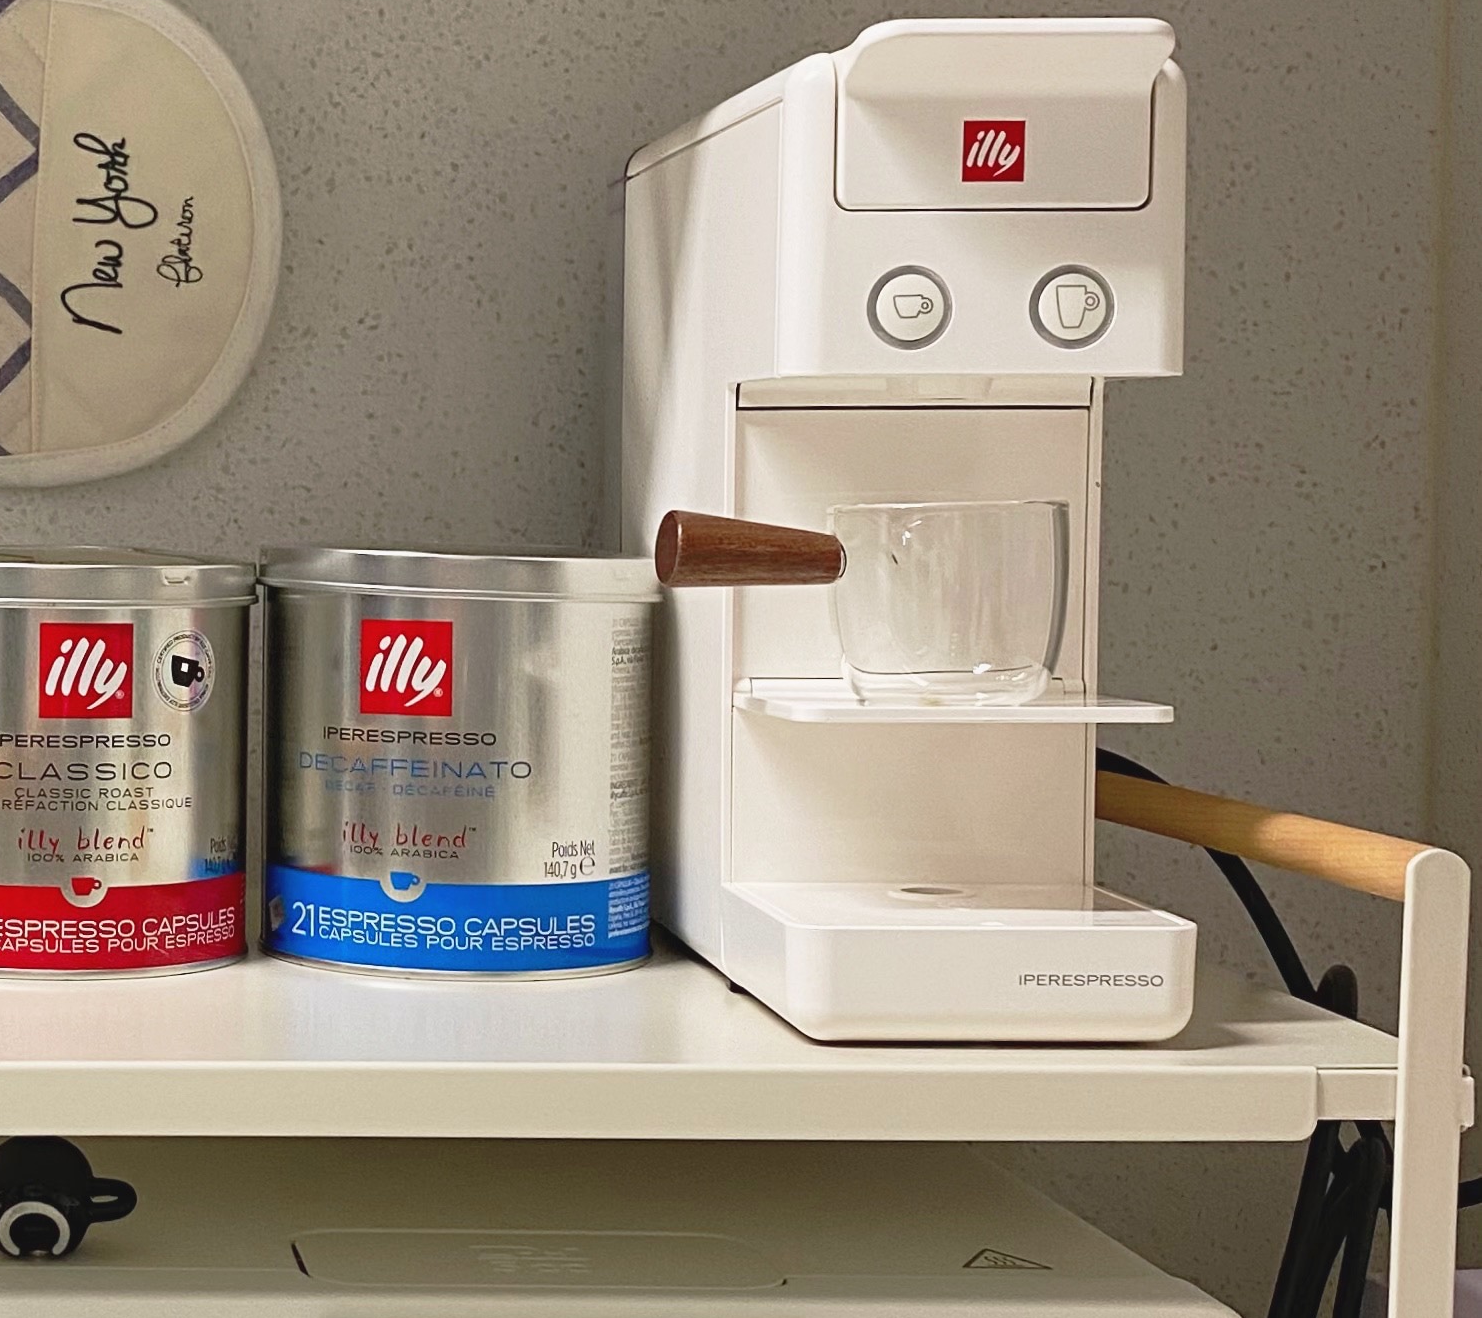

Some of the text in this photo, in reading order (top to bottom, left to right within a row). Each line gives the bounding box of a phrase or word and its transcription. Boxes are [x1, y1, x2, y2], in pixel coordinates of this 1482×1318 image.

[965, 129, 1021, 177] illy
[60, 132, 158, 335] New York
[322, 726, 497, 746] IPERESPRESSO
[299, 751, 532, 780] DECAFFEINATO
[14, 786, 155, 800] CLASSIC ROAST
[106, 796, 193, 812] CLASSIQUE
[18, 827, 60, 856] illy
[342, 820, 380, 849] illy
[27, 852, 140, 863] 100% ARABICA
[349, 844, 460, 860] 100% ARABICA
[551, 840, 595, 857] Poids Net
[543, 860, 569, 878] 140,7
[141, 906, 236, 936] CAPSULES
[291, 901, 596, 937] 21 ESPRESSO CAPSULES
[107, 938, 160, 953] POUR
[164, 925, 236, 949] ESPRESSO
[318, 926, 597, 951] CAPSULES POUR ESPRESSO
[1019, 974, 1164, 987] IPERESPRESSO
